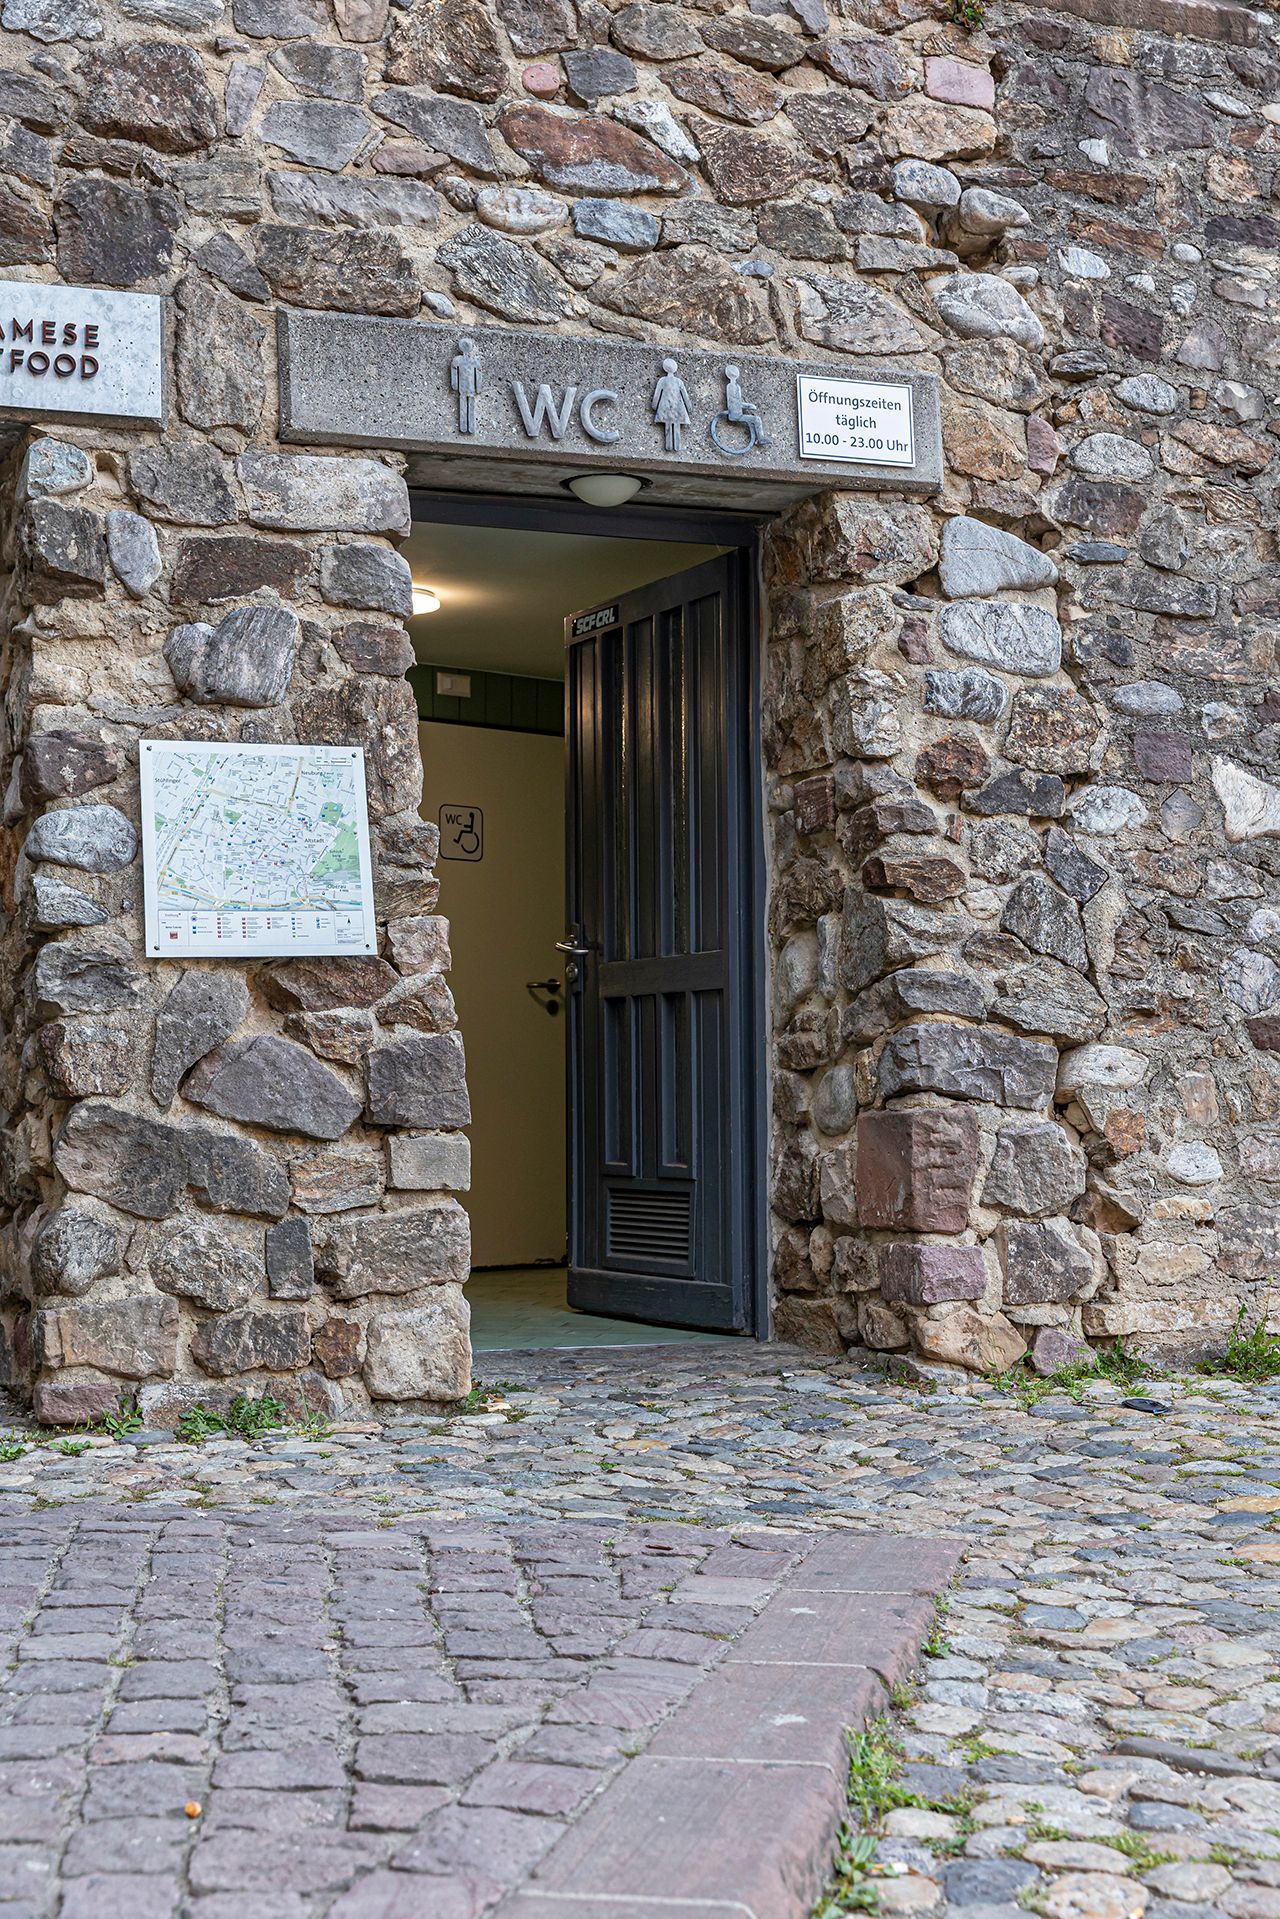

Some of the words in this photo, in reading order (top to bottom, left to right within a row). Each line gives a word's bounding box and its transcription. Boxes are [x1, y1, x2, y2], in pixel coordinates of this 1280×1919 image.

[0, 317, 100, 349] MESE
[808, 388, 902, 411] Öffnungszeiten
[509, 380, 620, 444] WC
[835, 414, 877, 430] täglich
[805, 432, 840, 446] 10.00
[849, 436, 884, 450] 23.00
[887, 439, 909, 452] Uhr
[445, 813, 463, 826] WC
